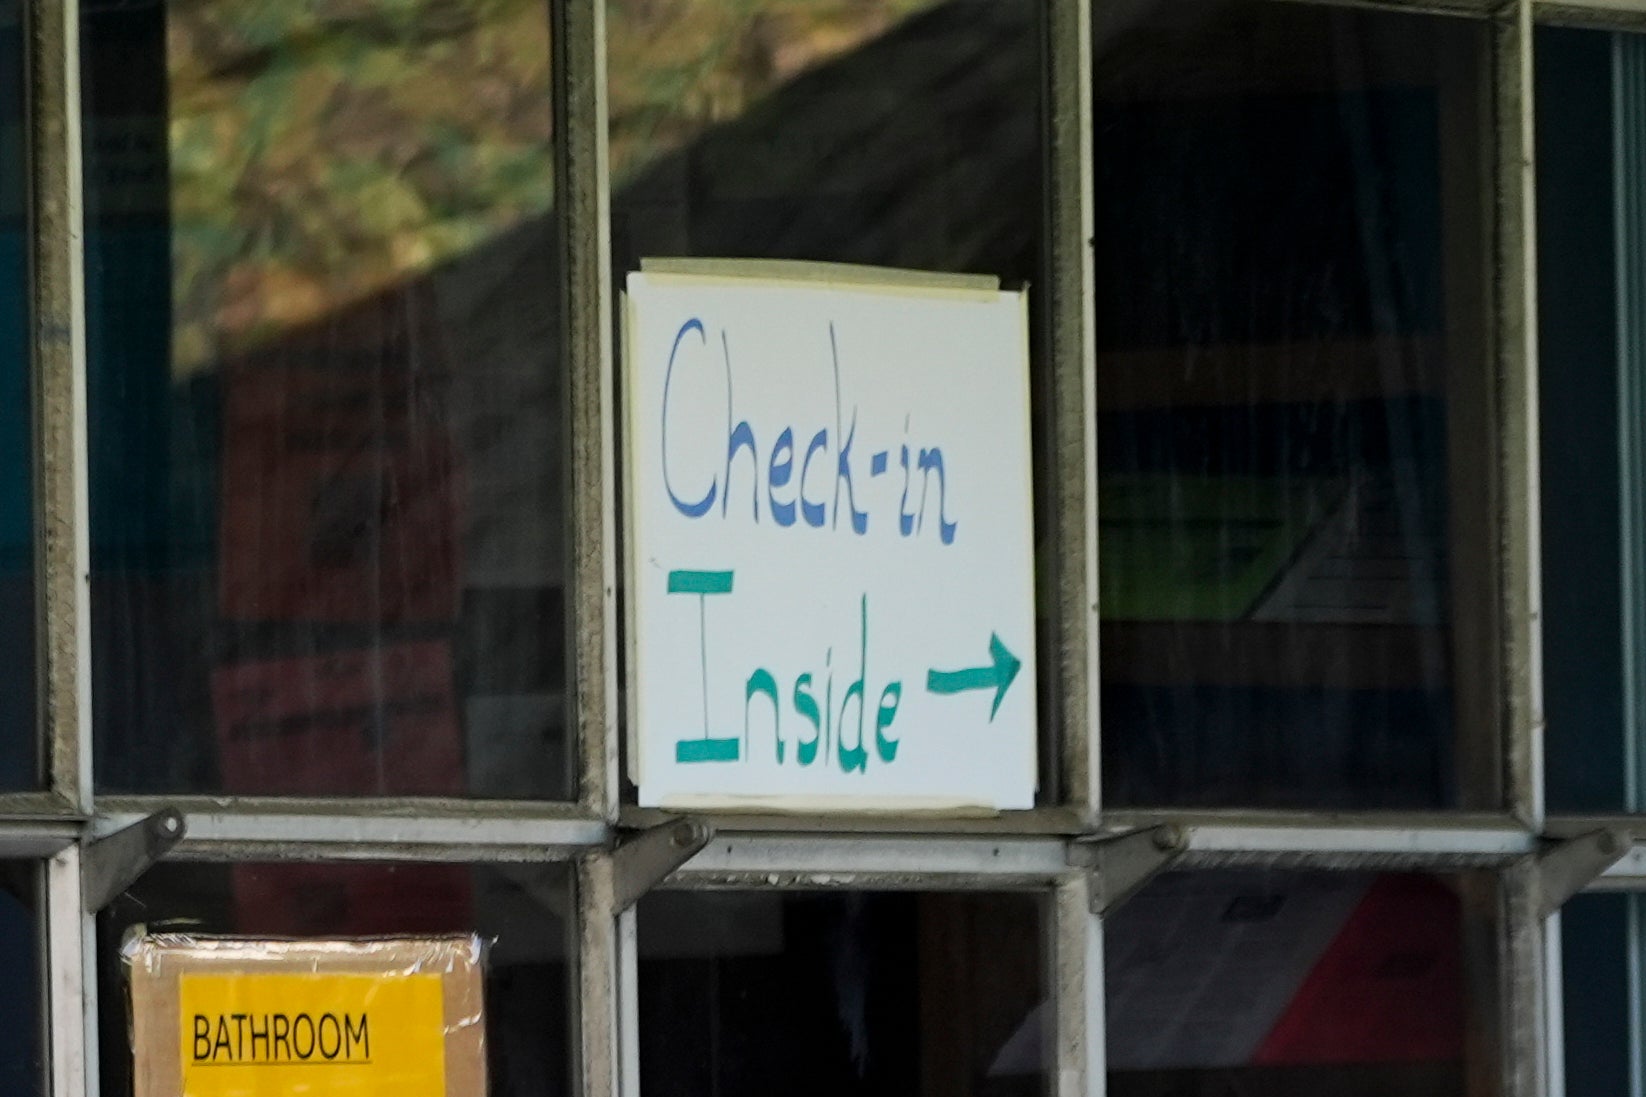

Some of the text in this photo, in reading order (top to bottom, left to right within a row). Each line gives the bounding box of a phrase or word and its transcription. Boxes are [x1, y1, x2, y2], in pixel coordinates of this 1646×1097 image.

[662, 317, 958, 546] Check-in
[667, 569, 902, 775] Inside
[193, 1012, 370, 1061] BATHROOM
